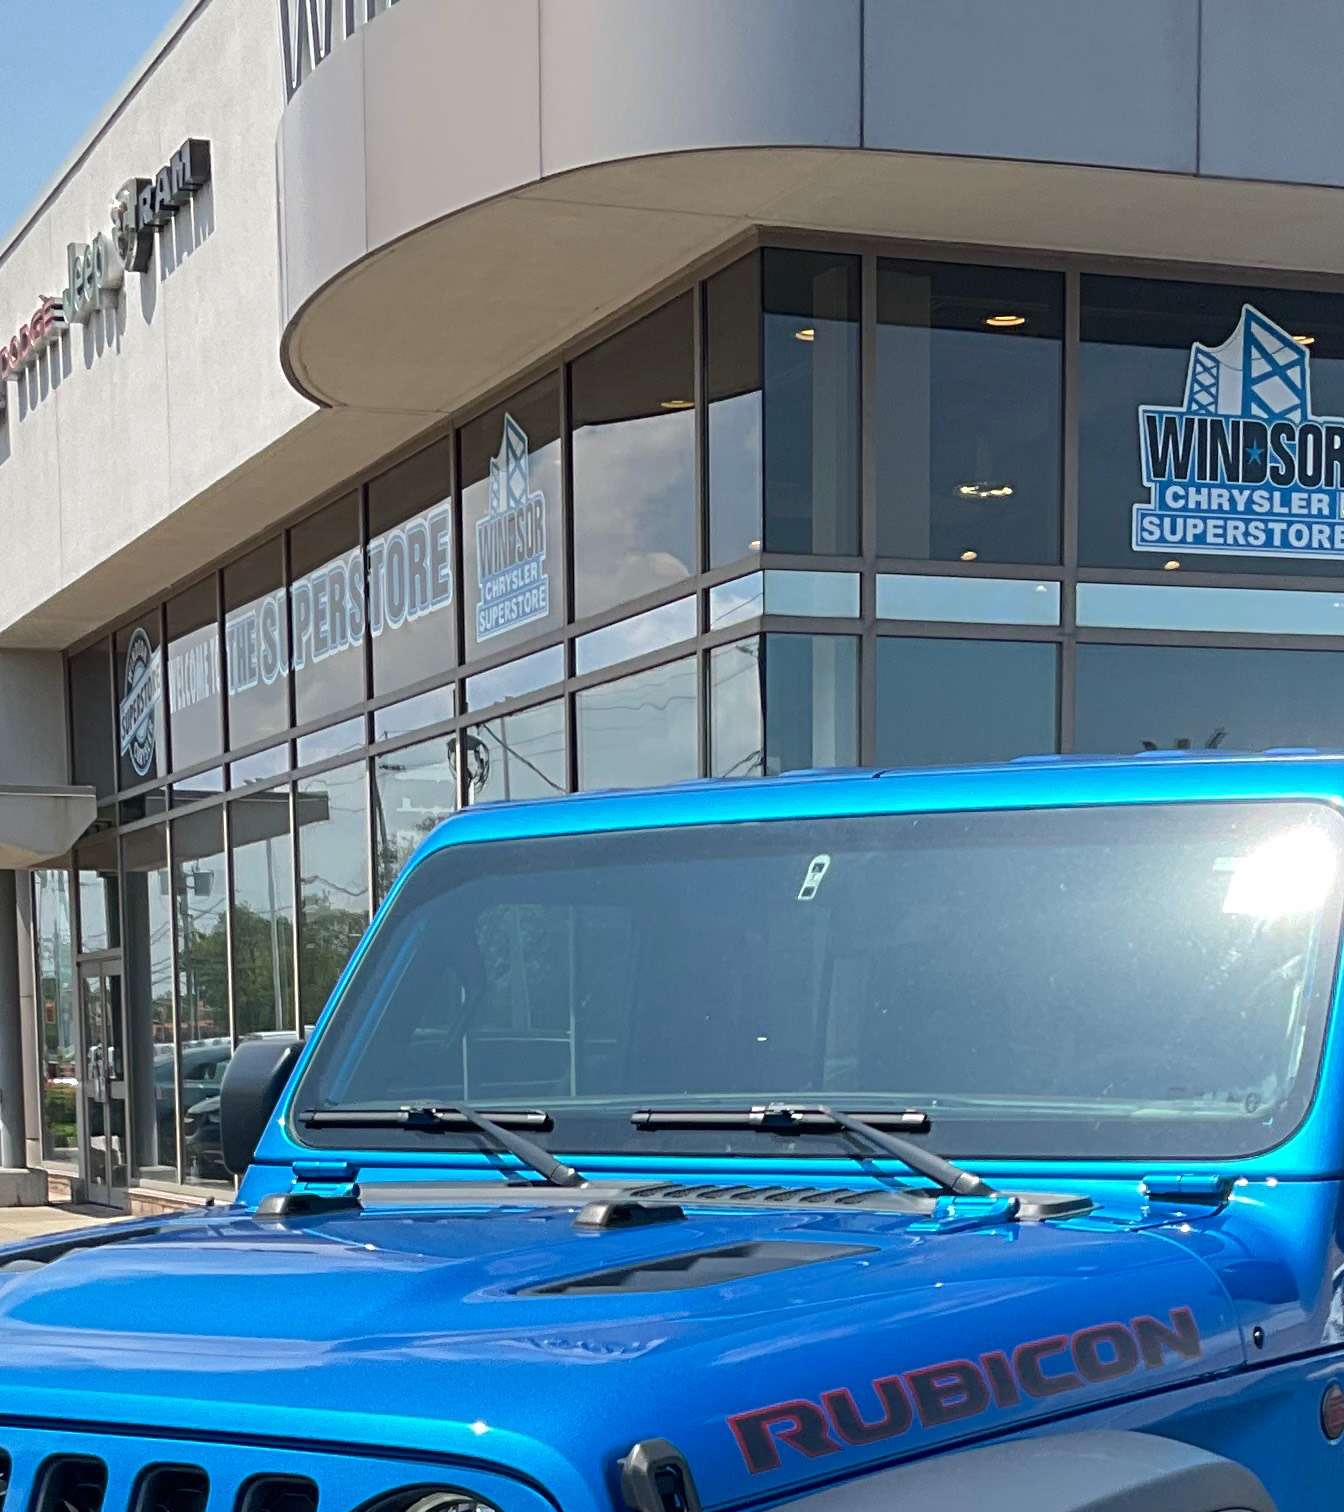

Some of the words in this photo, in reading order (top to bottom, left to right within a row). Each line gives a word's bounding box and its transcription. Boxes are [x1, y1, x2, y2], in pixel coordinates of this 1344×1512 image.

[137, 138, 211, 232] RAM
[62, 233, 123, 323] Jeep
[0, 297, 66, 379] DODGE
[478, 498, 544, 579] WINDSOR
[1164, 484, 1330, 516] CHRYSLER
[227, 610, 258, 695] THE
[260, 507, 452, 684] SUPERSTORE
[479, 586, 547, 632] SUPERSTORE
[485, 561, 538, 600] CHRYSLER
[727, 1306, 1202, 1475] RUBICON
